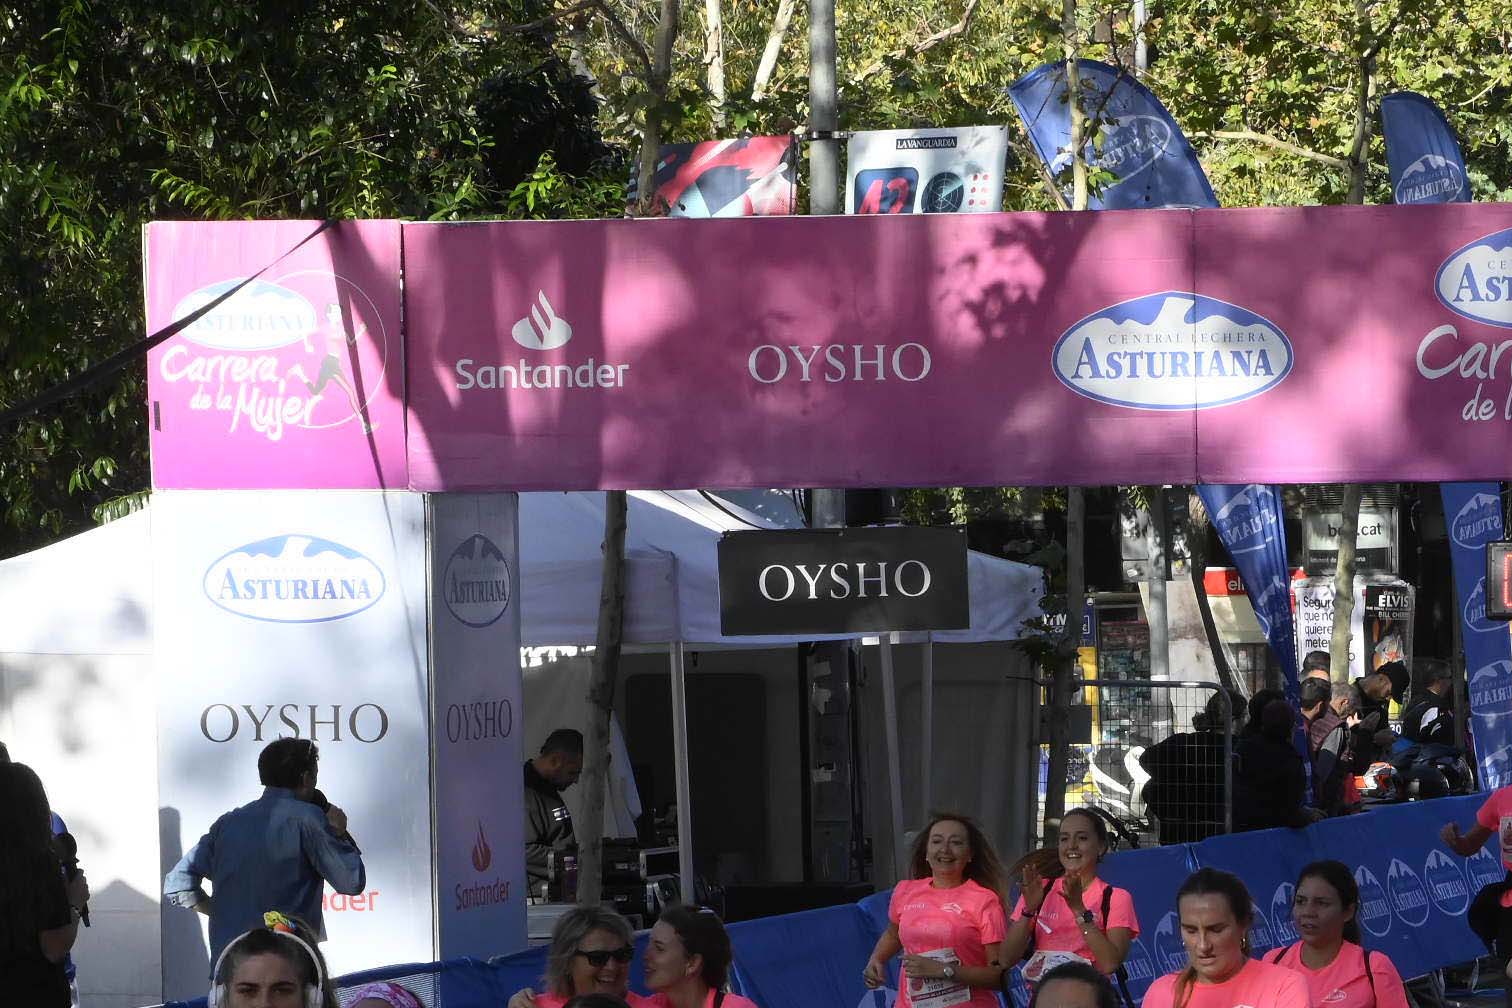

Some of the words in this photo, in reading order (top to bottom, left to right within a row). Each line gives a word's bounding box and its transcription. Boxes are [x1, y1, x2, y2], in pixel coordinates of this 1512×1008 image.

[1107, 333, 1182, 344] CENTRAL
[1192, 332, 1267, 343] LECHERA
[160, 345, 281, 383] Carrera
[456, 358, 630, 391] Santander
[748, 342, 931, 383] OYSHO
[1071, 335, 1275, 380] ASTURIANA
[190, 384, 213, 410] de
[216, 383, 232, 410] la
[230, 378, 324, 441] Mujer
[1462, 384, 1498, 421] de
[219, 566, 373, 600] ASTURIANA
[450, 575, 507, 605] ASTURIANA
[758, 560, 931, 601] OYSHO
[1304, 612, 1321, 624] que
[1378, 594, 1410, 608] ELVIS
[199, 703, 389, 744] OYSHO
[446, 700, 513, 744] OYSHO
[455, 877, 511, 911] Santander
